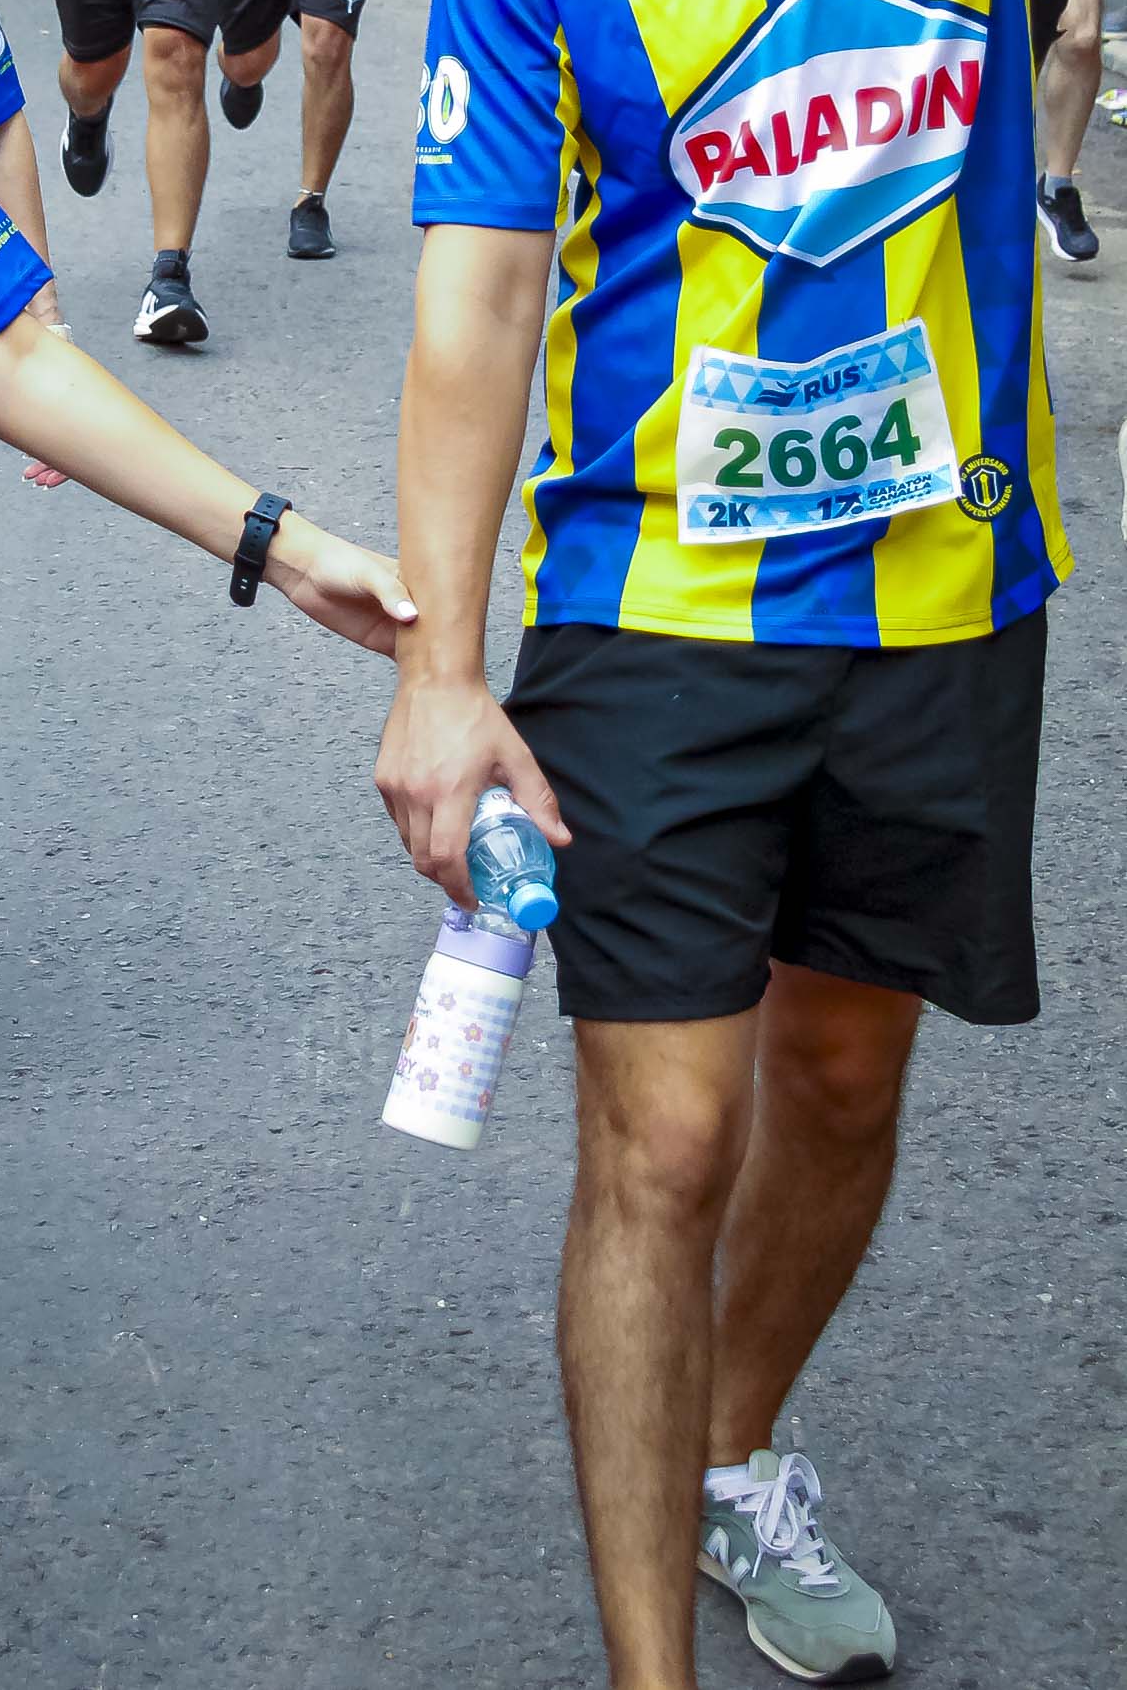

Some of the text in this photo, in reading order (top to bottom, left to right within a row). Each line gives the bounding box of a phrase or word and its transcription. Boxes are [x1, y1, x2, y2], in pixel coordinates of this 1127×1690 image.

[415, 55, 470, 144] 0
[684, 59, 980, 193] PALADIN
[712, 397, 922, 489] 2664
[707, 501, 753, 528] 2K
[867, 473, 932, 499] MARATÓN
[868, 483, 932, 506] CANALLA
